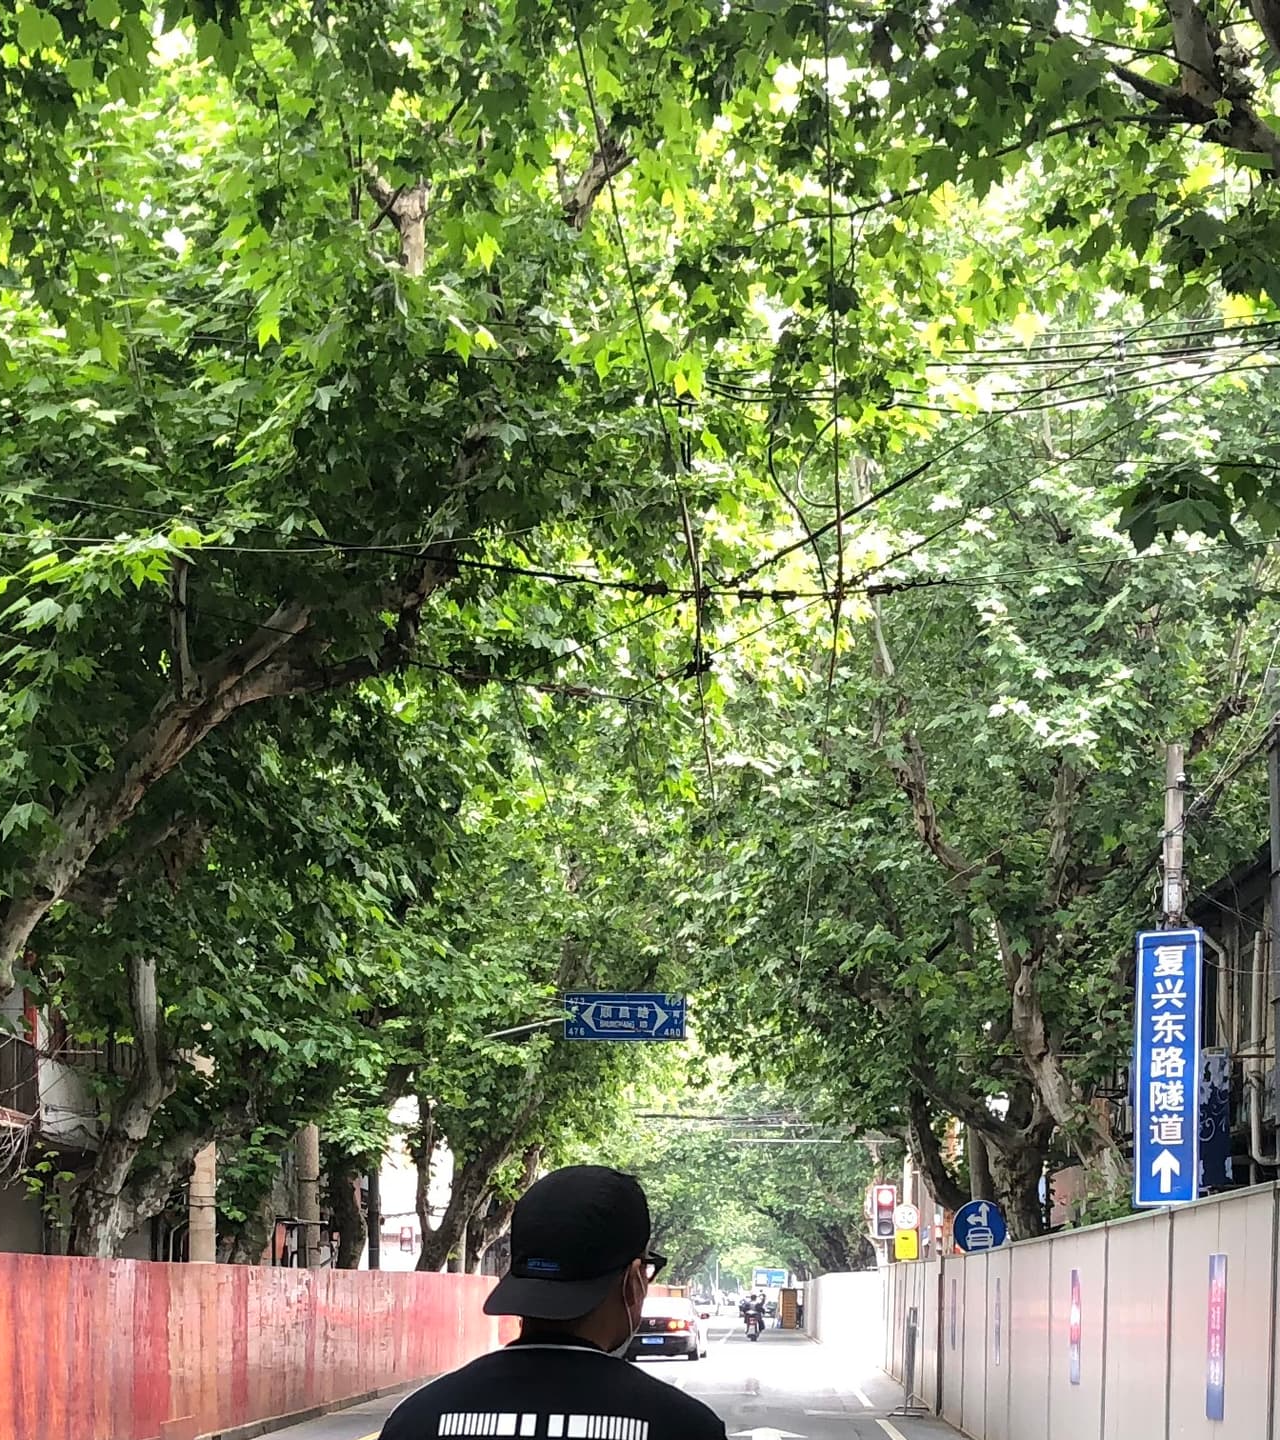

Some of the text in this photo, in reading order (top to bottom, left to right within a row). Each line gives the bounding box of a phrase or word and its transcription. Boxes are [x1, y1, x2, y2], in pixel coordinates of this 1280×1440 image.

[1149, 945, 1187, 1146] 复兴东路隧道
